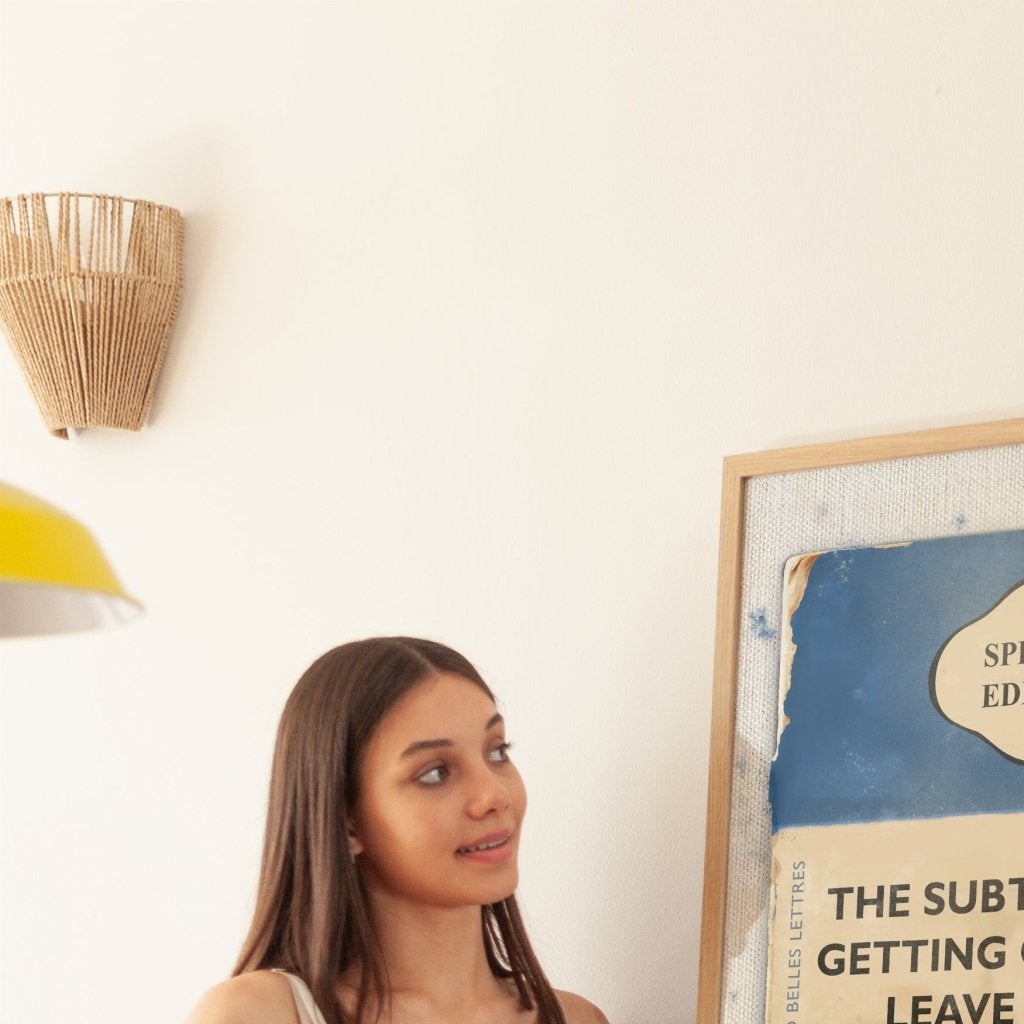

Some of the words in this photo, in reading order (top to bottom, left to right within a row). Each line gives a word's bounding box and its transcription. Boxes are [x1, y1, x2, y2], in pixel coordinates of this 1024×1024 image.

[789, 861, 806, 941] LETTRES
[828, 882, 910, 920] THE
[786, 949, 802, 1012] BELLES
[818, 936, 1005, 976] GETTING
